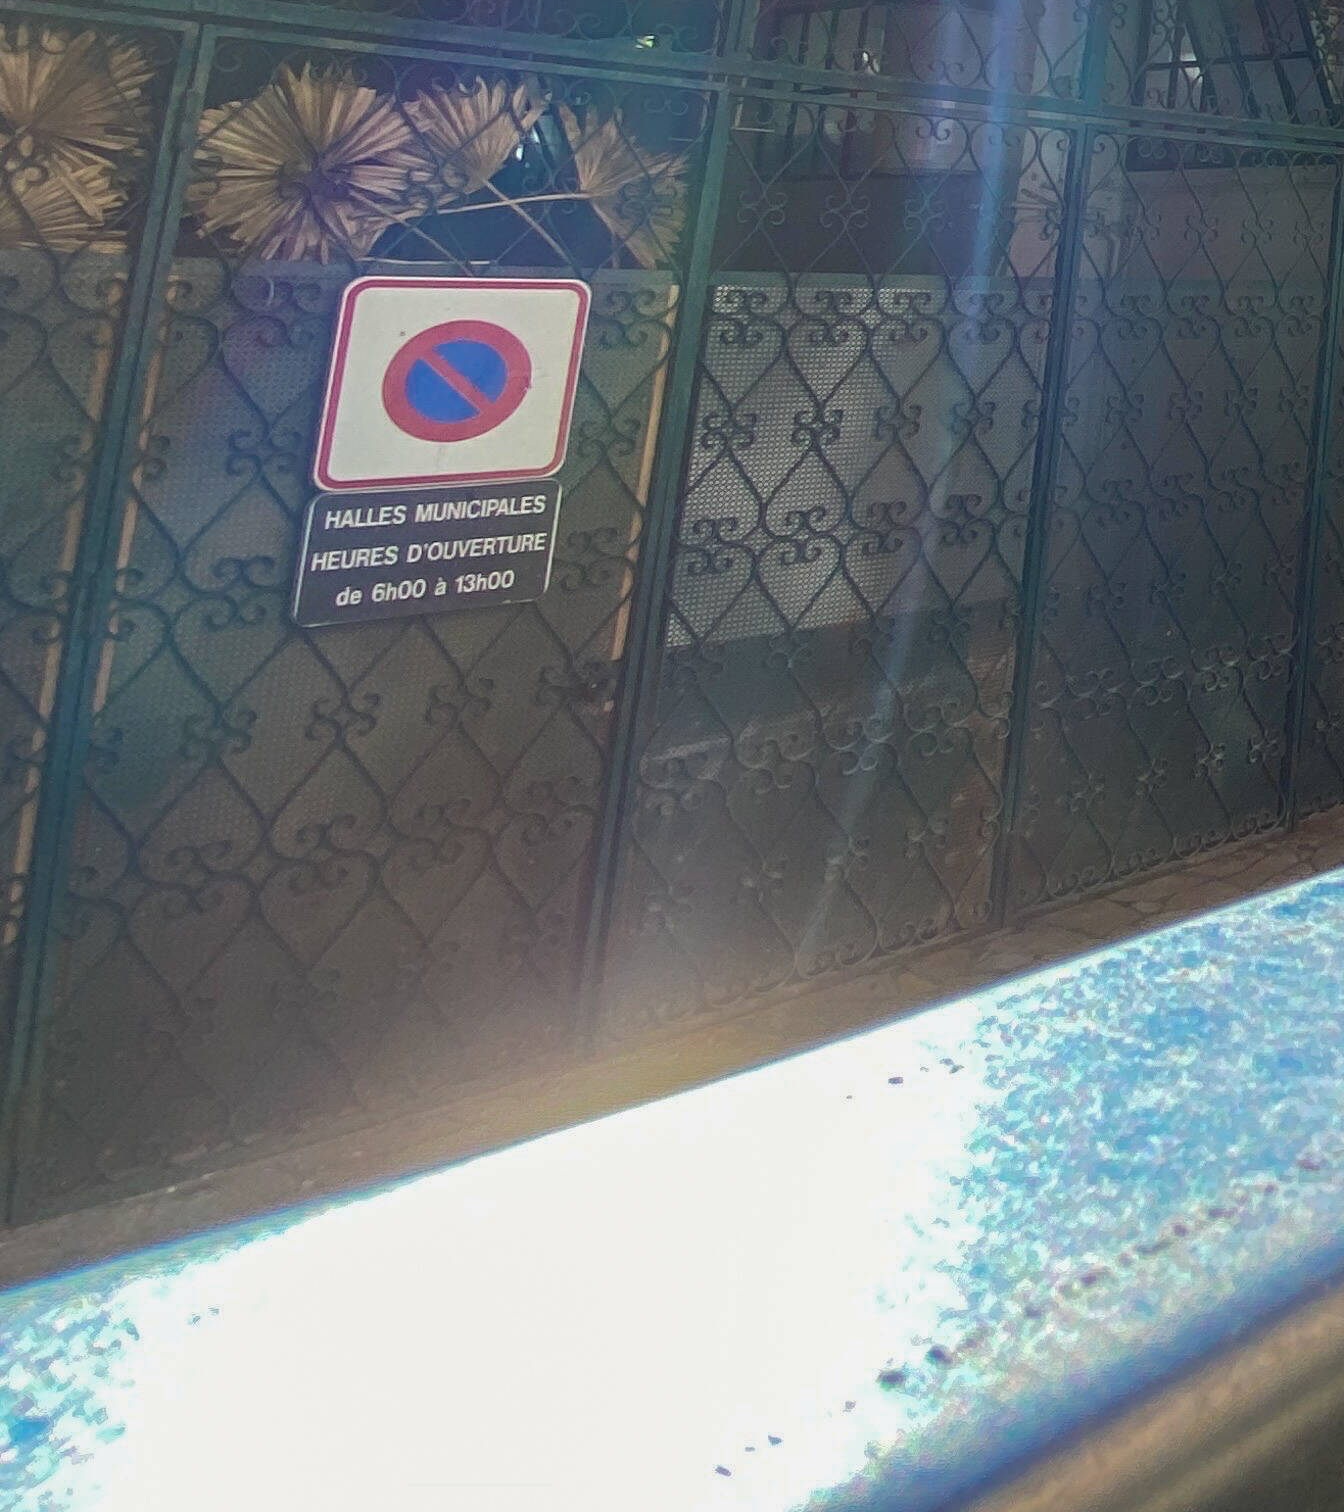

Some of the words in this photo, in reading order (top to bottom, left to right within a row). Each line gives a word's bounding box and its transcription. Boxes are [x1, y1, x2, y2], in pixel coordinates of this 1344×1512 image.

[324, 504, 408, 531] HALLES
[414, 495, 548, 524] MUNICIPALES
[311, 545, 399, 572] HEURES
[406, 533, 548, 564] D'OUVERTURE
[335, 585, 362, 607] de
[371, 578, 427, 603] 6h00
[434, 577, 447, 597] à
[454, 570, 516, 595] 13h00
